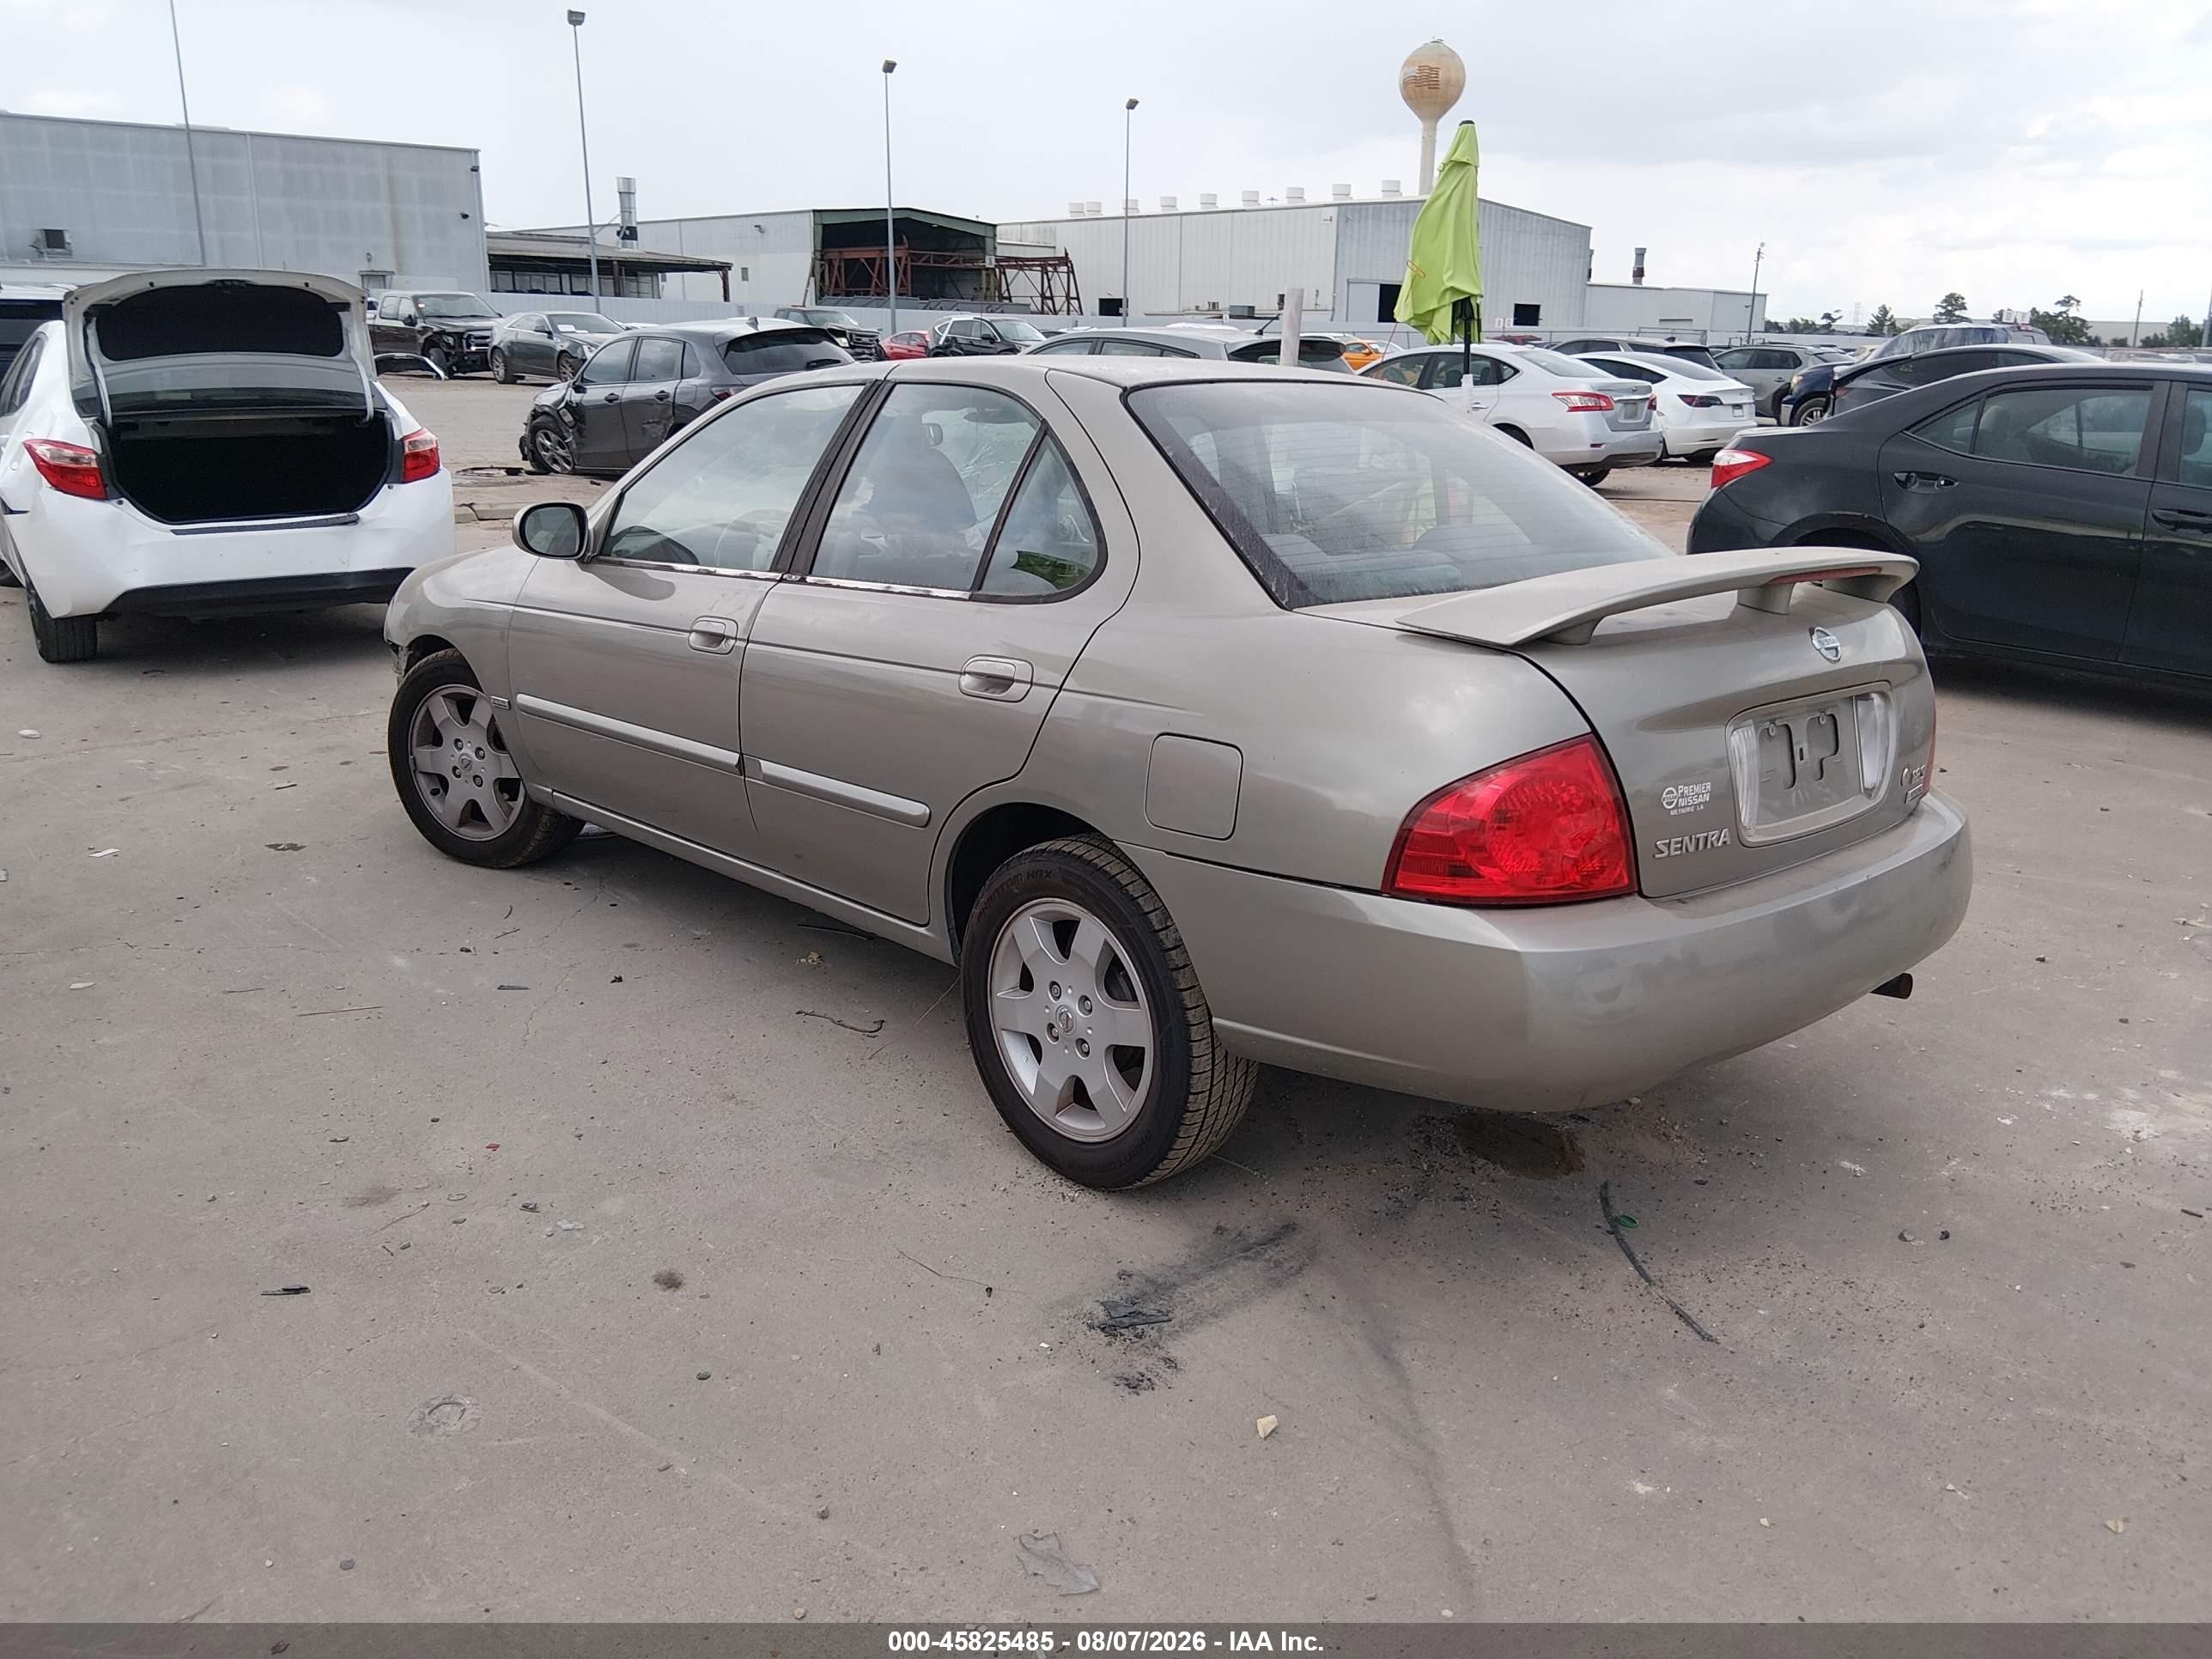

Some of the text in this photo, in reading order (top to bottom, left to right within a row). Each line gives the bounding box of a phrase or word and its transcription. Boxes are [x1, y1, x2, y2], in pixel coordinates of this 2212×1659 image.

[1678, 782, 1711, 797] PREMIER
[1678, 793, 1710, 807] NISSAN
[1654, 828, 1731, 859] SENTRA
